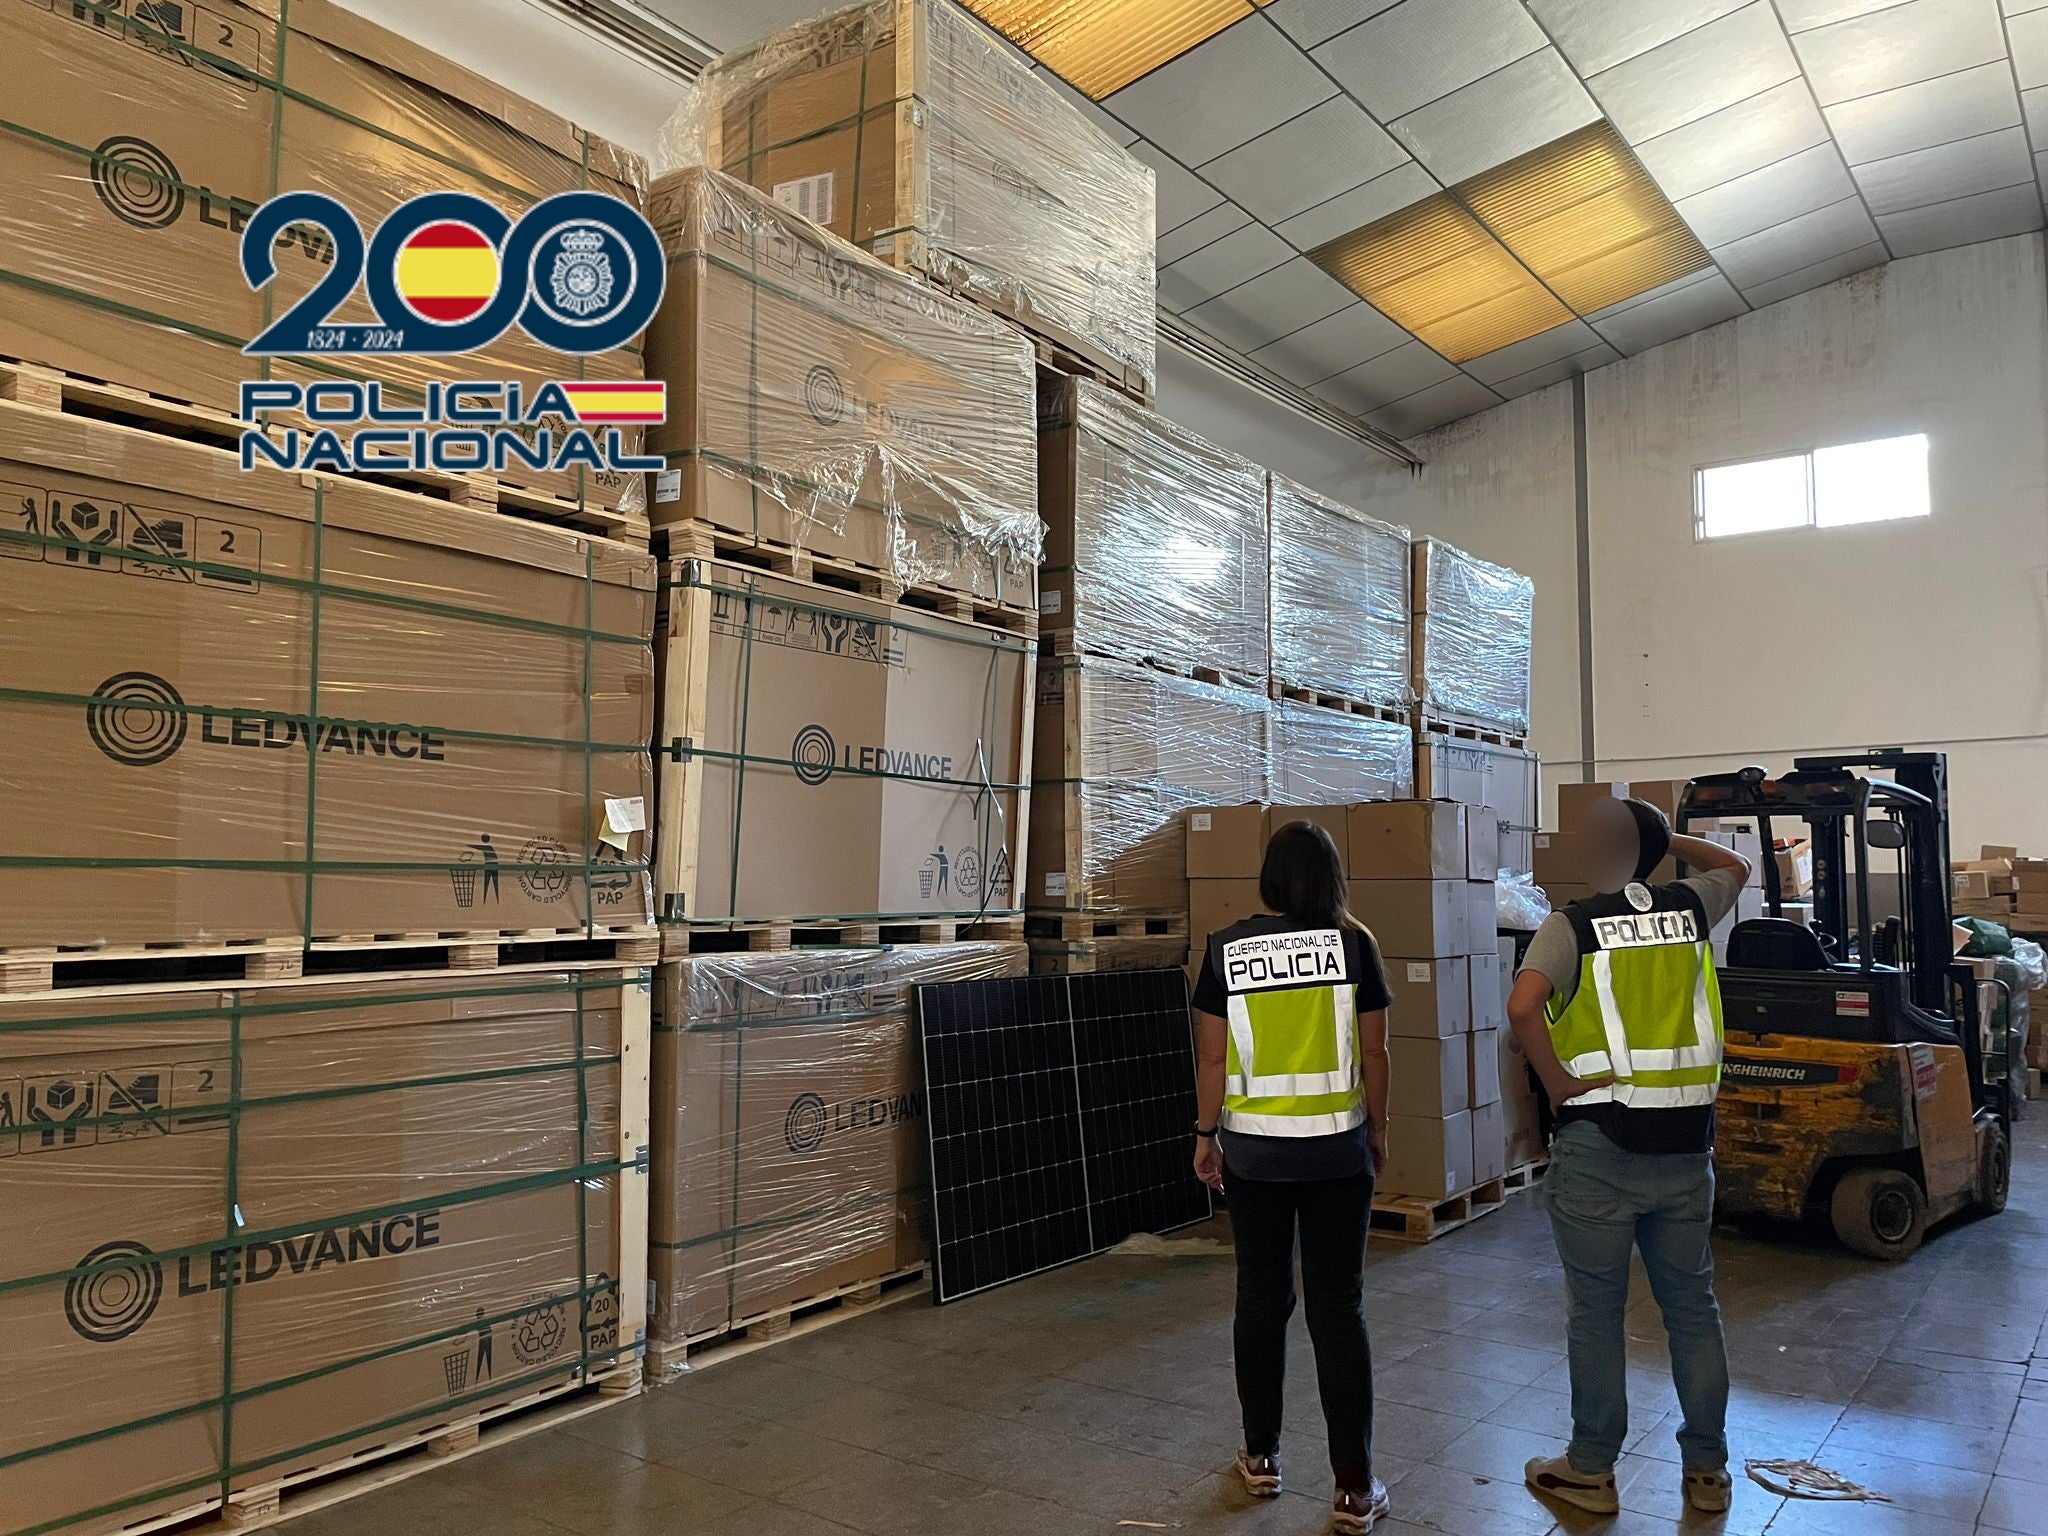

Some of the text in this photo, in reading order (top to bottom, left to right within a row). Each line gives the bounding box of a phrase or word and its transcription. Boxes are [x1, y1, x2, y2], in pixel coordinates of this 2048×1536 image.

[218, 24, 234, 47] 2
[595, 472, 622, 489] PAP
[219, 530, 235, 553] 2
[1009, 578, 1024, 589] PAP
[202, 705, 446, 761] LEDVANCE
[844, 744, 953, 781] LEDVANCE
[597, 891, 624, 905] PAP
[994, 887, 1009, 897] PAP
[1597, 915, 1695, 945] POLICIA
[1227, 934, 1339, 957] CUERPO NACIONAL DE
[1229, 951, 1341, 985] POLICIA
[197, 1069, 214, 1093] 2
[1721, 1063, 1806, 1081] NGHEINRICH
[834, 1090, 923, 1133] LEDVAN
[178, 1208, 441, 1298] LEDVANCE
[595, 1297, 610, 1314] 20
[590, 1329, 617, 1350] PAP
